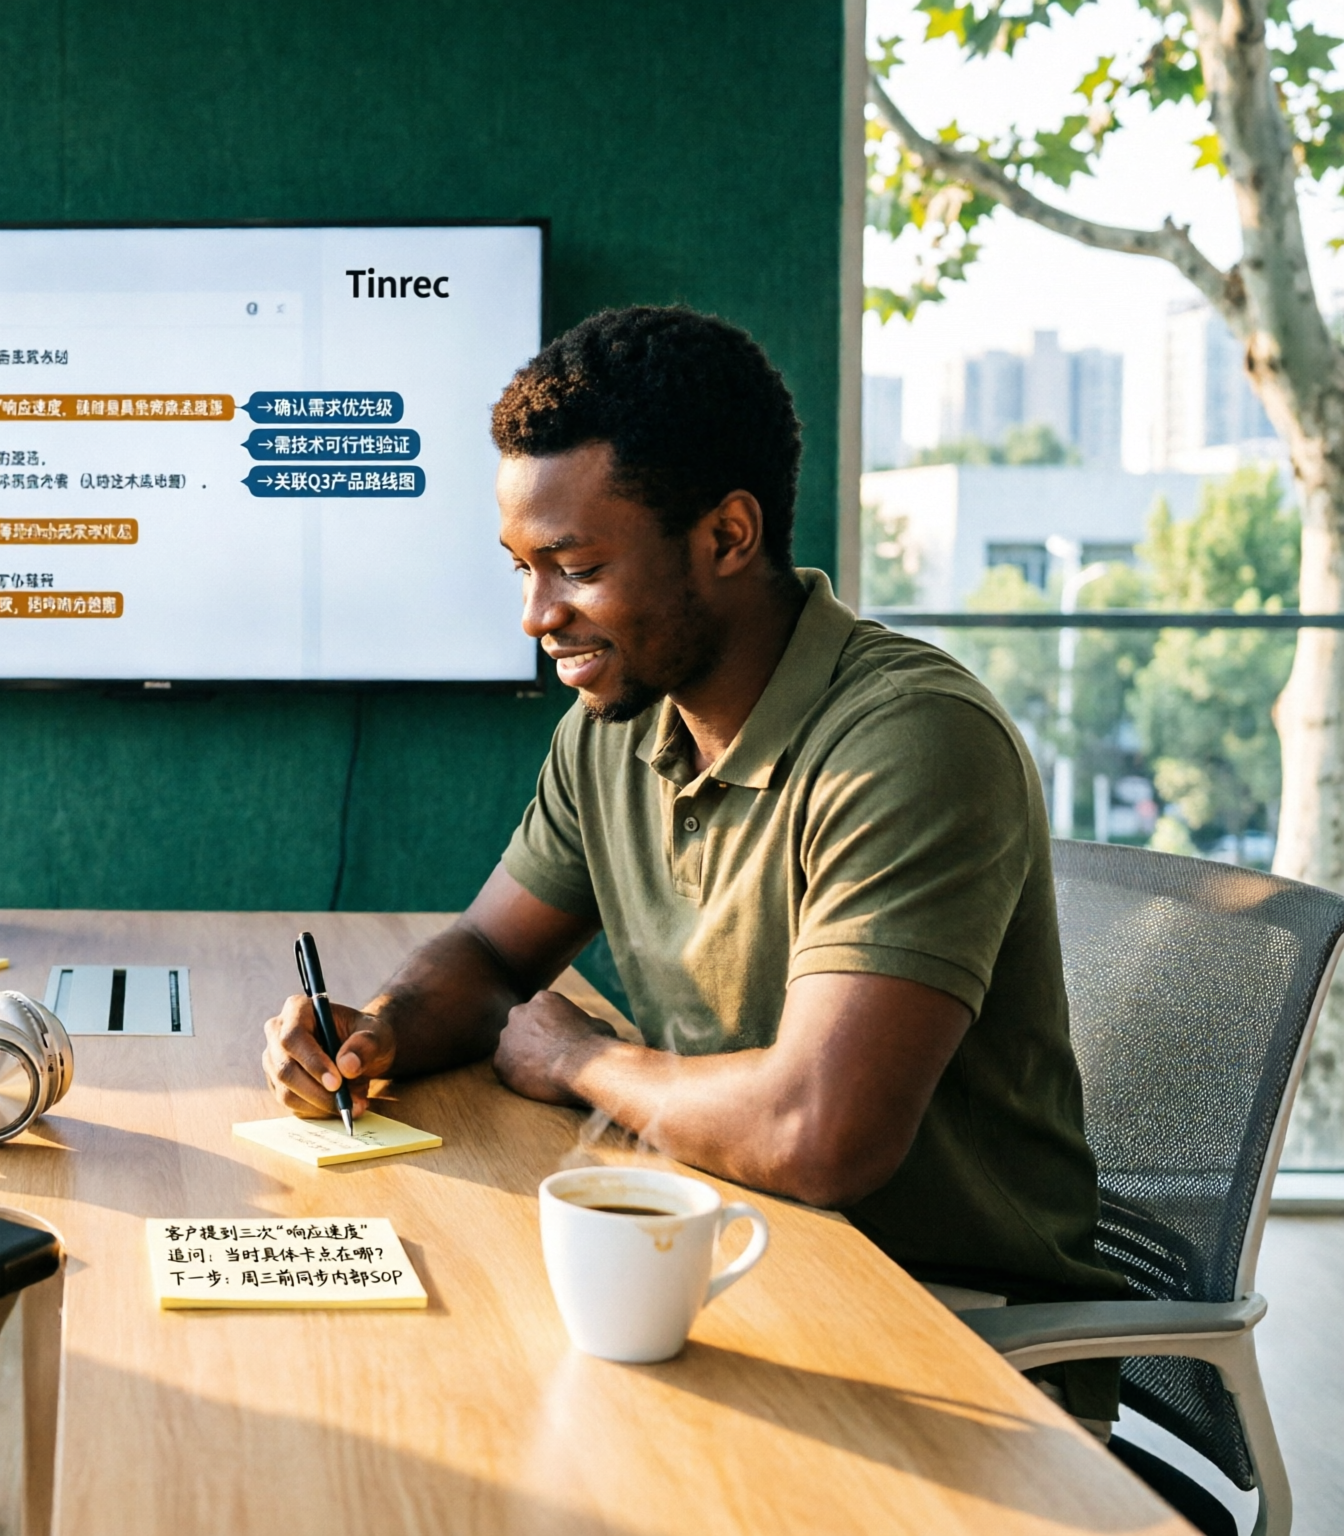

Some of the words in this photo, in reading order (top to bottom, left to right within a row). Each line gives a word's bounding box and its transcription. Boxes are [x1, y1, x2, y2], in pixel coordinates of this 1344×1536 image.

[345, 267, 450, 299] Tinrec
[273, 397, 394, 418] 确认需求优先级
[273, 434, 411, 455] 需技术可行性验证
[273, 471, 417, 492] 关联Q3产品路线图
